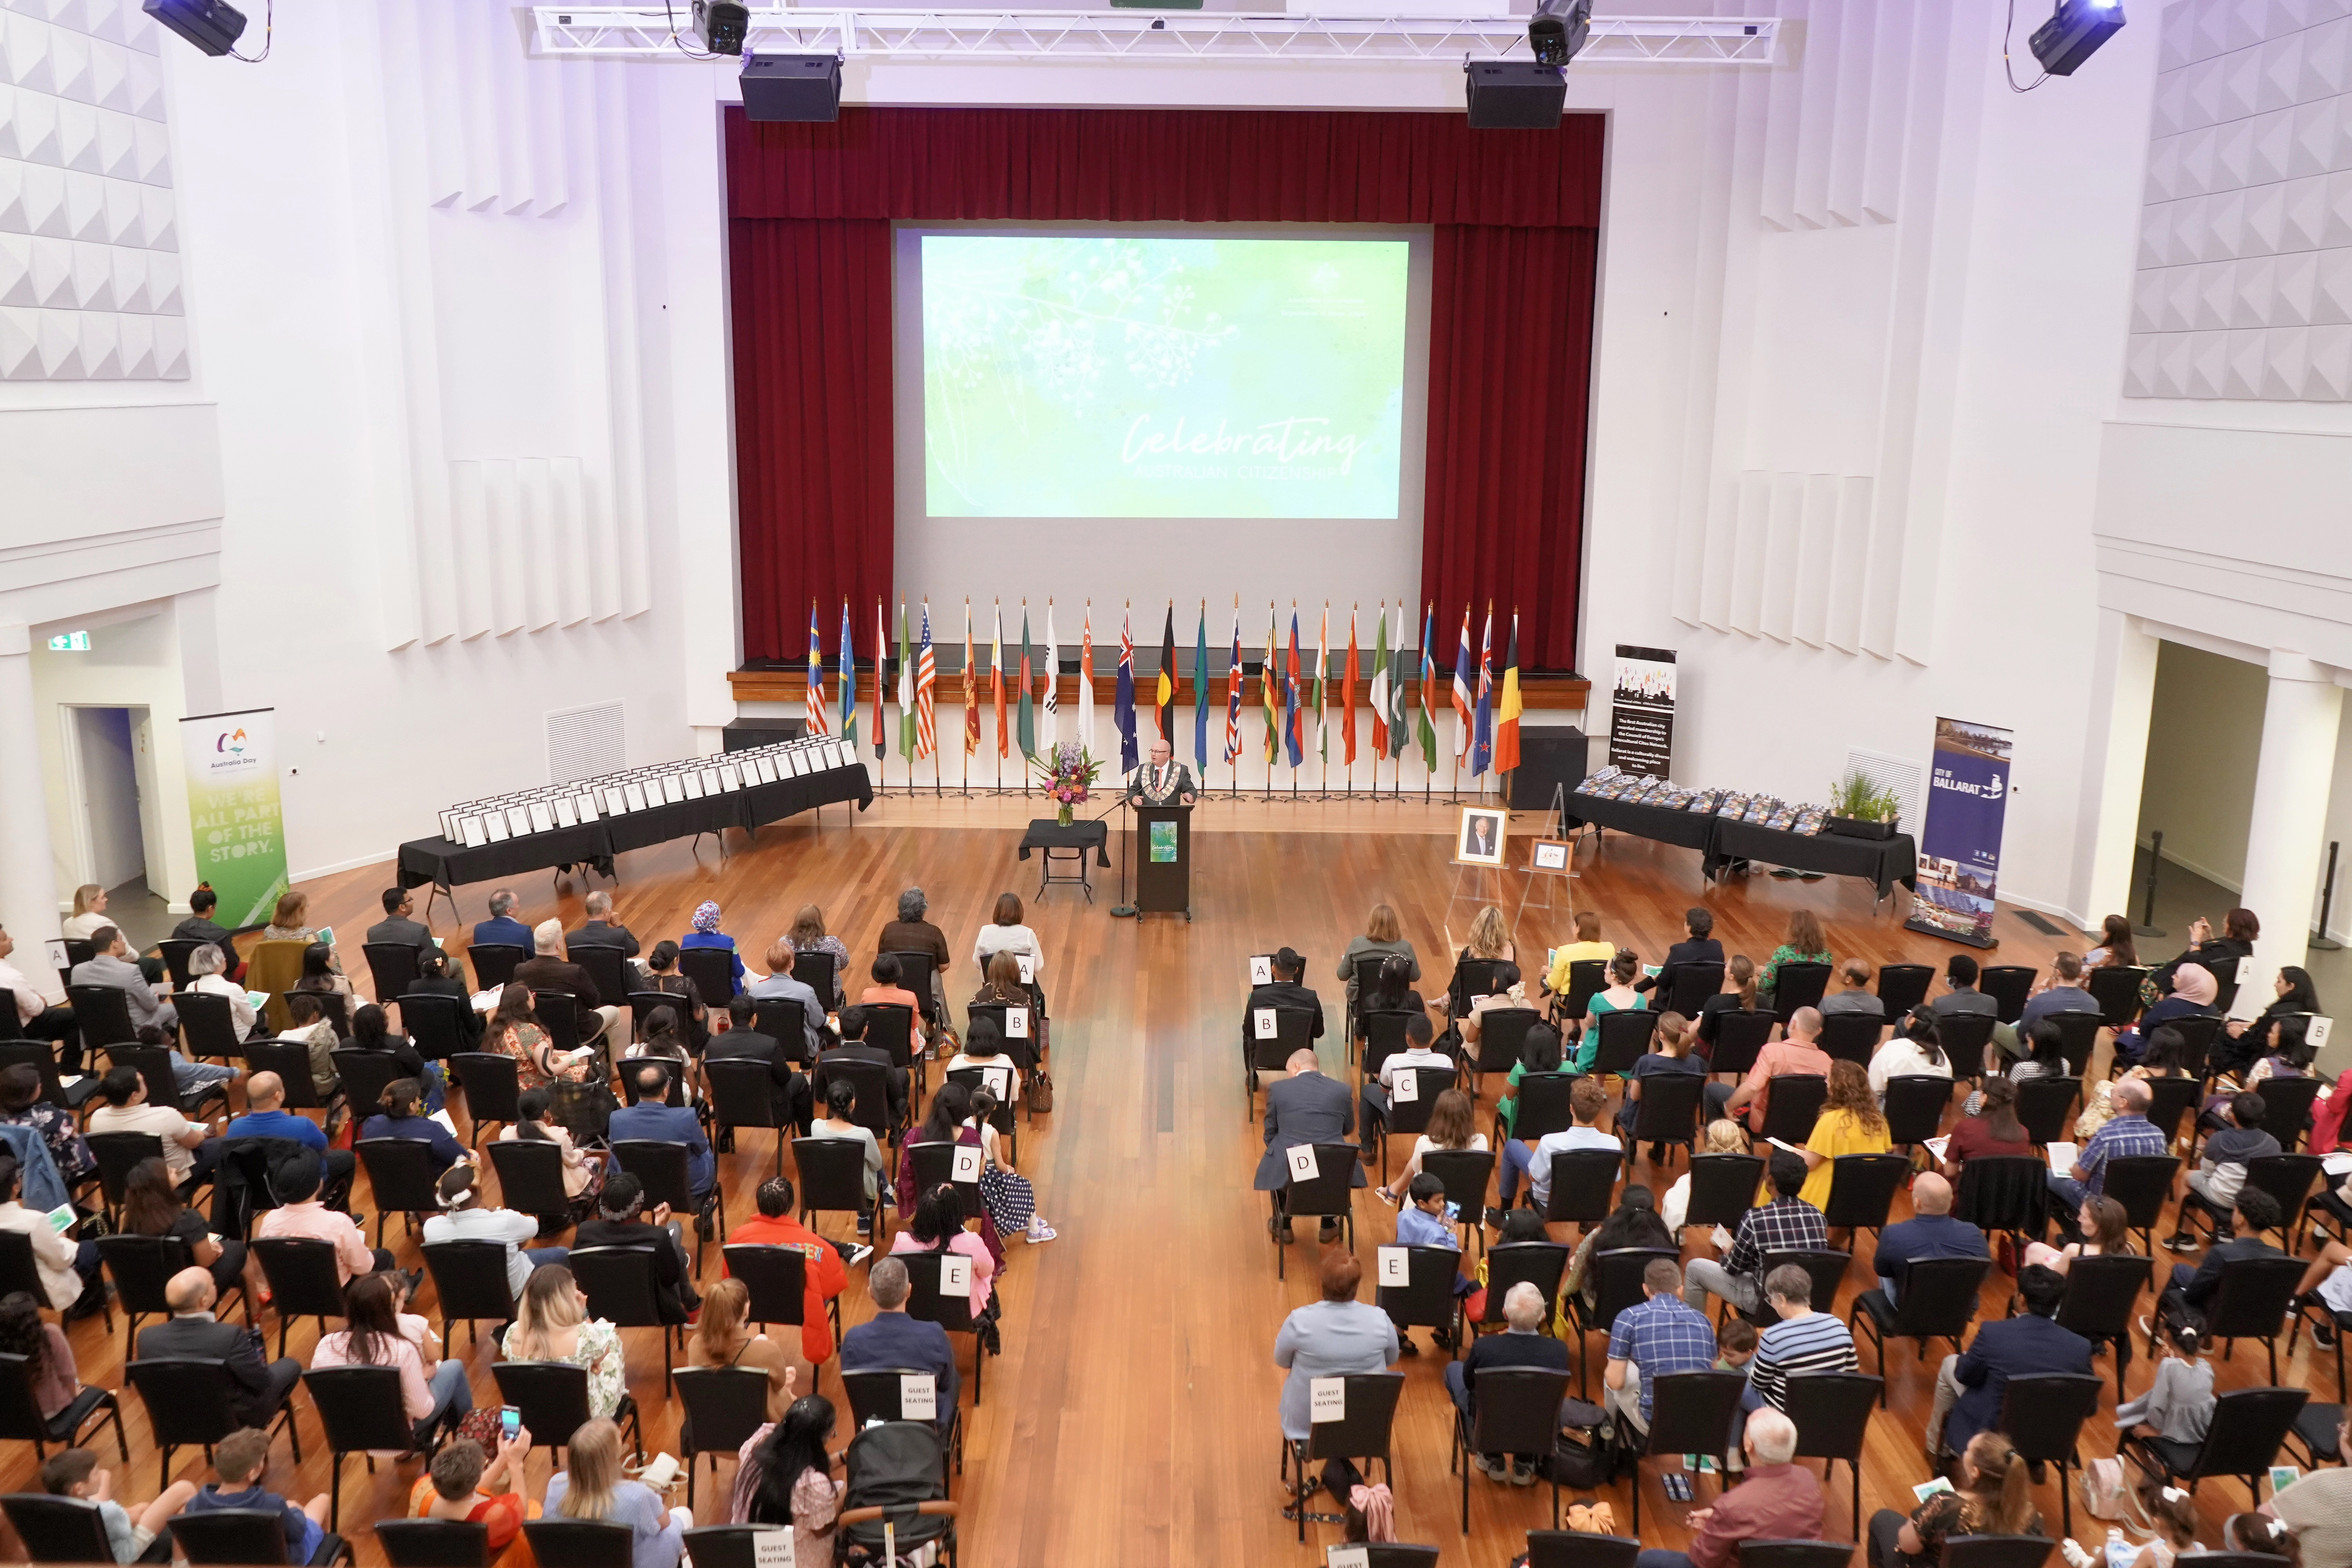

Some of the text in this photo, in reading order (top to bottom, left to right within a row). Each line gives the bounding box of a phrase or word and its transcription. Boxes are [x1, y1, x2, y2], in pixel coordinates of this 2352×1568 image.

[1122, 414, 1368, 476] Celebrating
[1133, 465, 1338, 481] AUSTRALIAN CITIZENSHIP
[211, 759, 241, 768] Australia
[1935, 768, 1945, 777] CITY
[1933, 777, 1981, 795] BALLARAT
[207, 788, 265, 809] WE'RE
[195, 802, 280, 829] ALL PART
[208, 822, 273, 844] OF THE
[210, 839, 273, 862] STORY.
[53, 950, 62, 961] A
[1020, 964, 1028, 975] A
[1257, 965, 1265, 976] A
[2243, 965, 2249, 976] A
[1013, 1017, 1021, 1028] B
[1263, 1018, 1270, 1029] B
[2315, 1026, 2324, 1037] B
[990, 1078, 999, 1090] C
[1401, 1079, 1411, 1091] C
[960, 1157, 972, 1171] D
[1297, 1156, 1309, 1169] D
[1389, 1259, 1399, 1274] E
[951, 1269, 960, 1283] E
